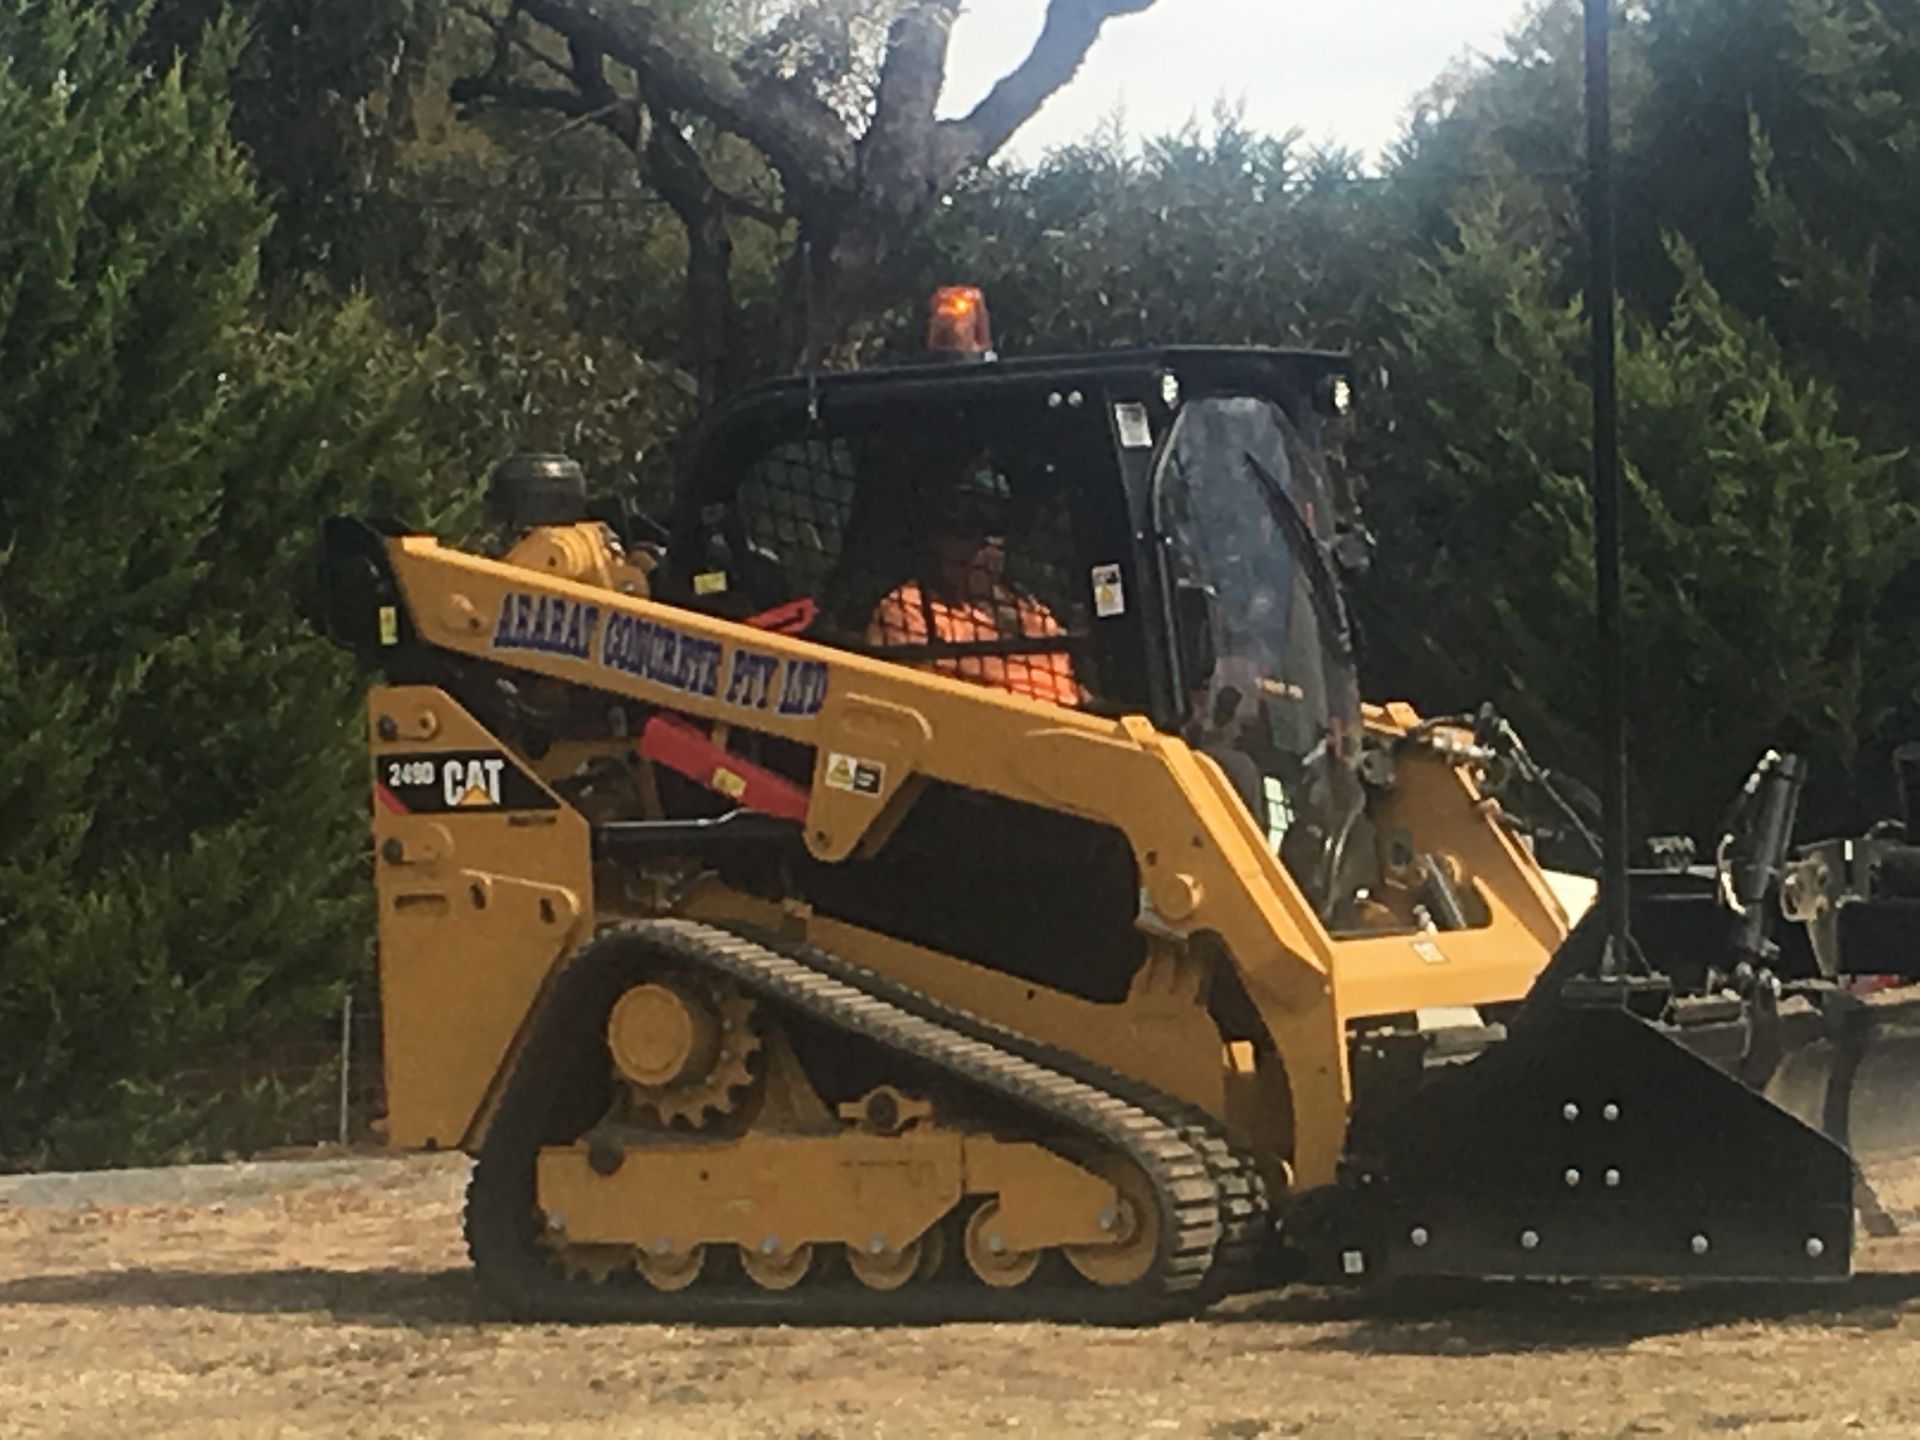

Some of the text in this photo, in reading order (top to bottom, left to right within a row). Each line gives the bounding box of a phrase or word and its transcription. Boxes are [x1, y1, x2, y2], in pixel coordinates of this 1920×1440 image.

[725, 648, 780, 709] PTY
[777, 658, 829, 718] LTD
[443, 759, 504, 806] CAT
